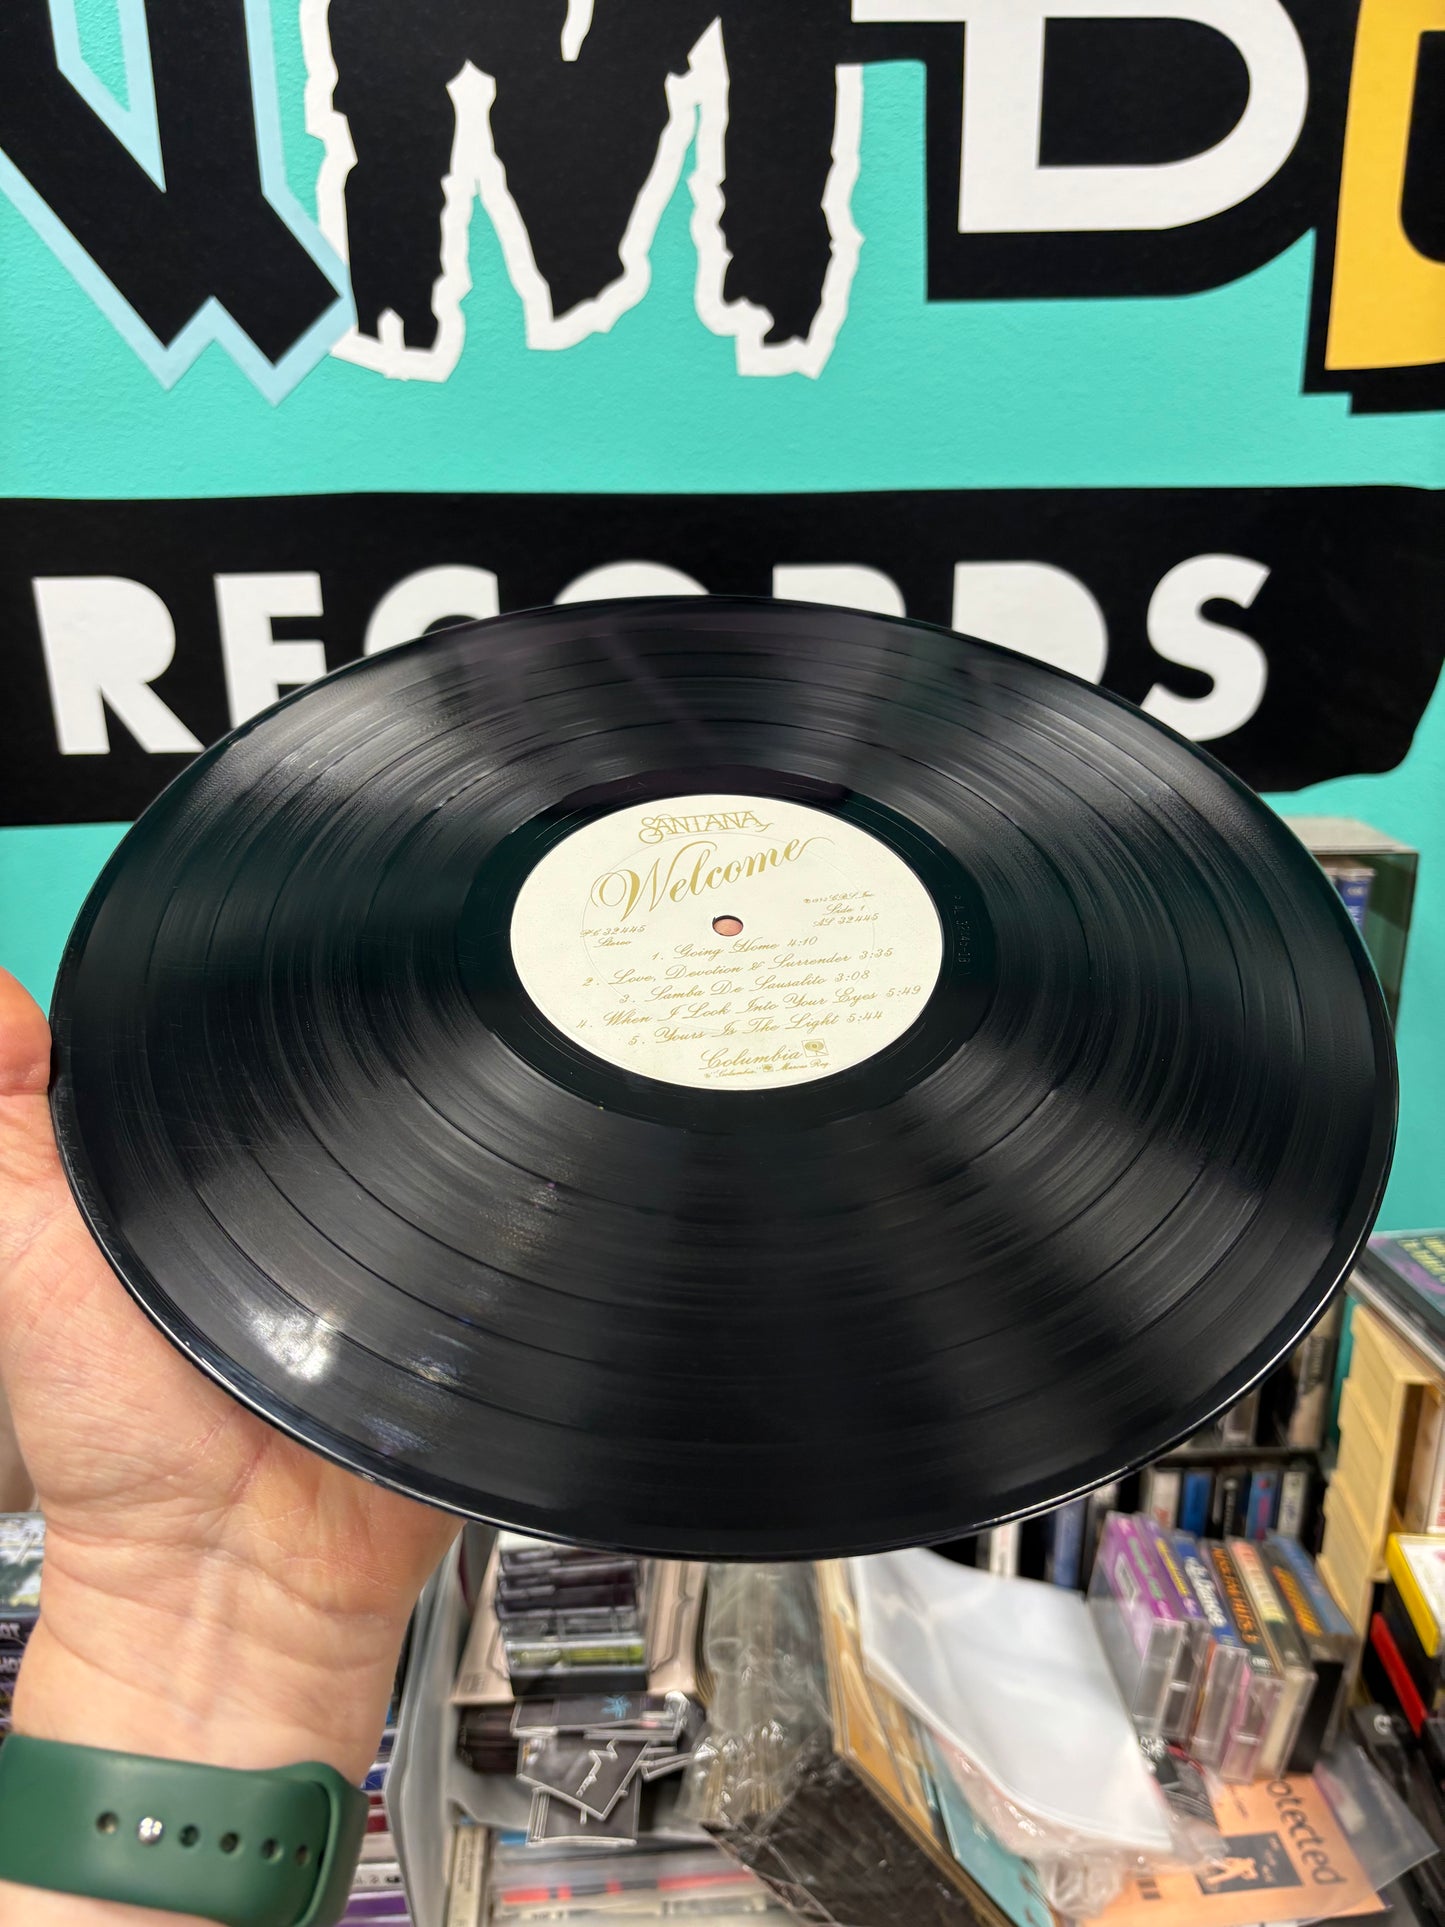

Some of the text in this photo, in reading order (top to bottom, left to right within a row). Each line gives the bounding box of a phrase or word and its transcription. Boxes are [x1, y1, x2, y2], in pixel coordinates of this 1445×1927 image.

[638, 810, 774, 844] SANTANA
[590, 837, 836, 922] Welcome
[822, 902, 853, 915] Side
[838, 912, 880, 924] 32445
[593, 937, 632, 948] Stereo
[602, 924, 646, 936] 32445
[673, 943, 724, 962] Going
[728, 936, 780, 953] Home
[787, 936, 819, 948] 4:10
[608, 969, 656, 985] Love,
[664, 964, 743, 980] Devotion
[748, 961, 766, 970] &
[768, 953, 853, 970] Surrender
[858, 947, 894, 959] 3:35
[644, 985, 706, 1002] Samba
[710, 979, 745, 996] De
[749, 973, 828, 992] Sausalito
[834, 969, 871, 983] 3:08
[602, 1008, 653, 1027] When
[657, 1004, 689, 1022] I
[682, 1001, 731, 1019] Look
[735, 996, 779, 1015] Into
[782, 993, 828, 1009] Your
[832, 987, 878, 1008] Eyes
[885, 985, 922, 998] 5:49
[654, 1026, 706, 1044] Yours
[711, 1019, 740, 1038] Is
[742, 1017, 781, 1035] The
[785, 1012, 840, 1034] Light
[846, 1010, 884, 1023] 5:44
[698, 1044, 804, 1070] Columbia
